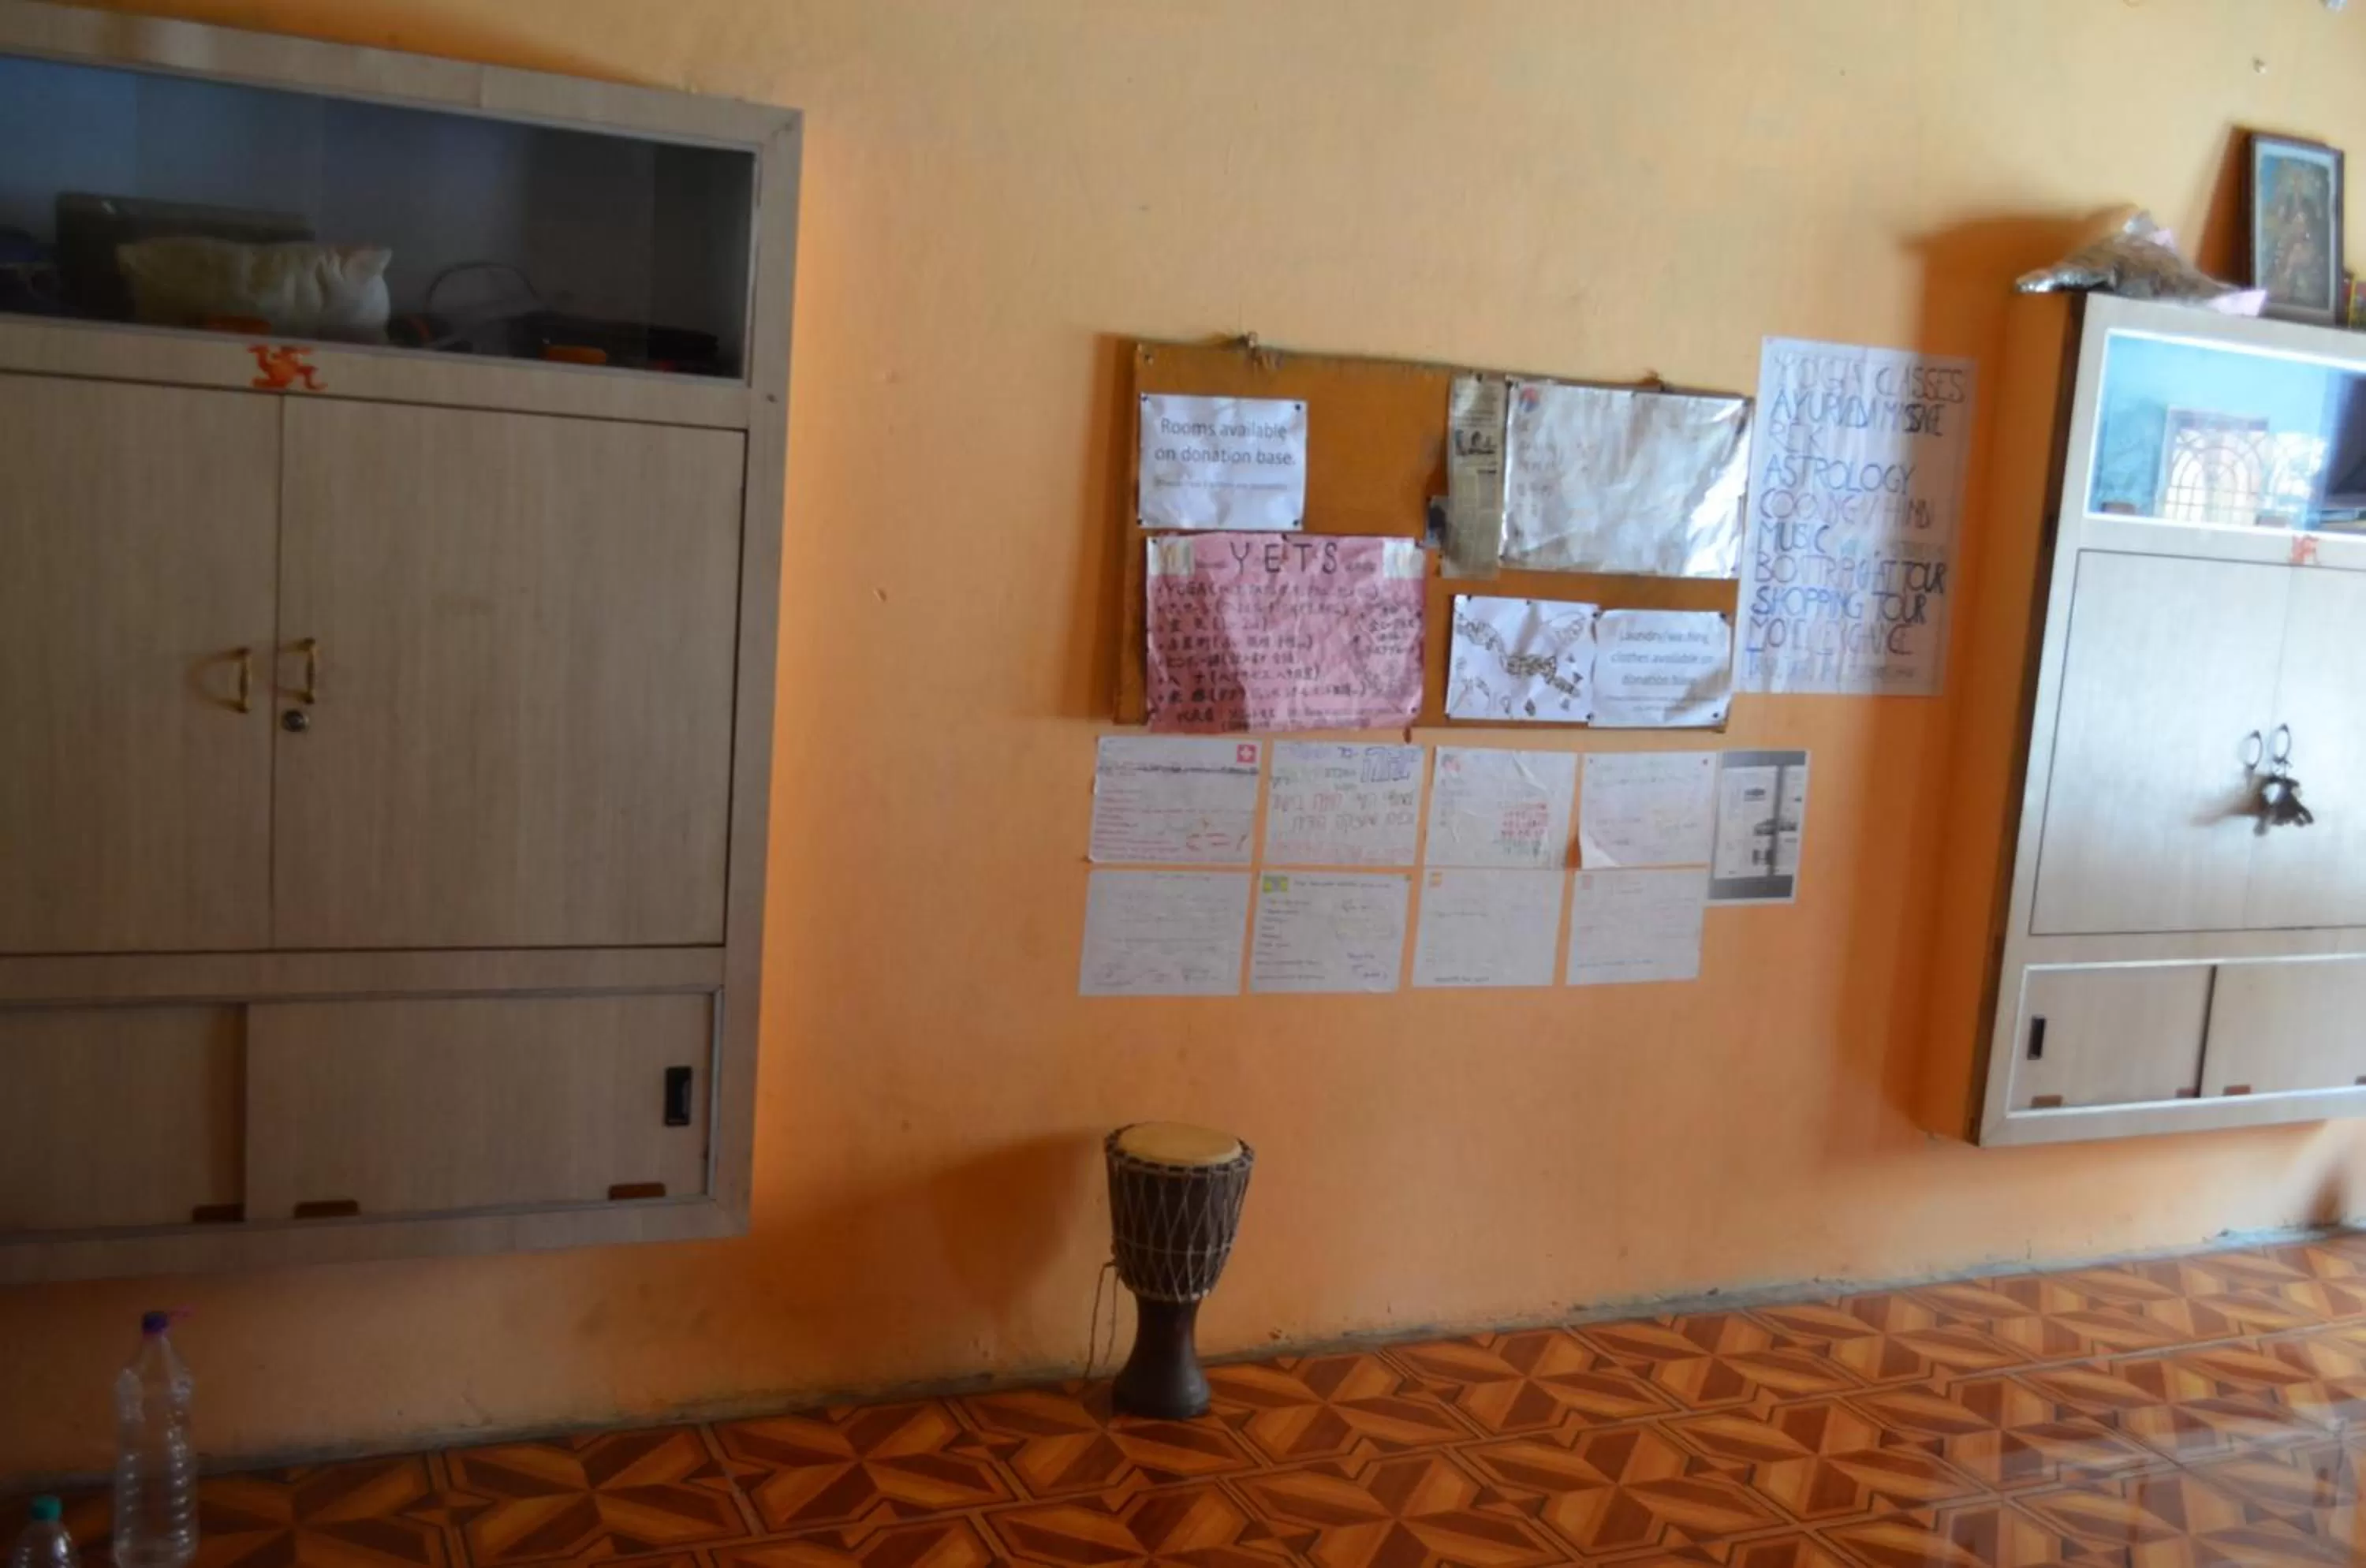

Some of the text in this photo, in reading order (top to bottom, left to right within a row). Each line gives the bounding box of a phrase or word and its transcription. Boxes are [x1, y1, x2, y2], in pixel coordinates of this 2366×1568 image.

[1160, 416, 1288, 439] Rooms available
[1154, 447, 1177, 461] on
[1181, 444, 1252, 464] donation
[1763, 453, 1917, 495] ASTROLOGY
[1757, 520, 1830, 553] MUSIC
[1230, 541, 1338, 575] YETS
[1872, 591, 1927, 625] TOUR
